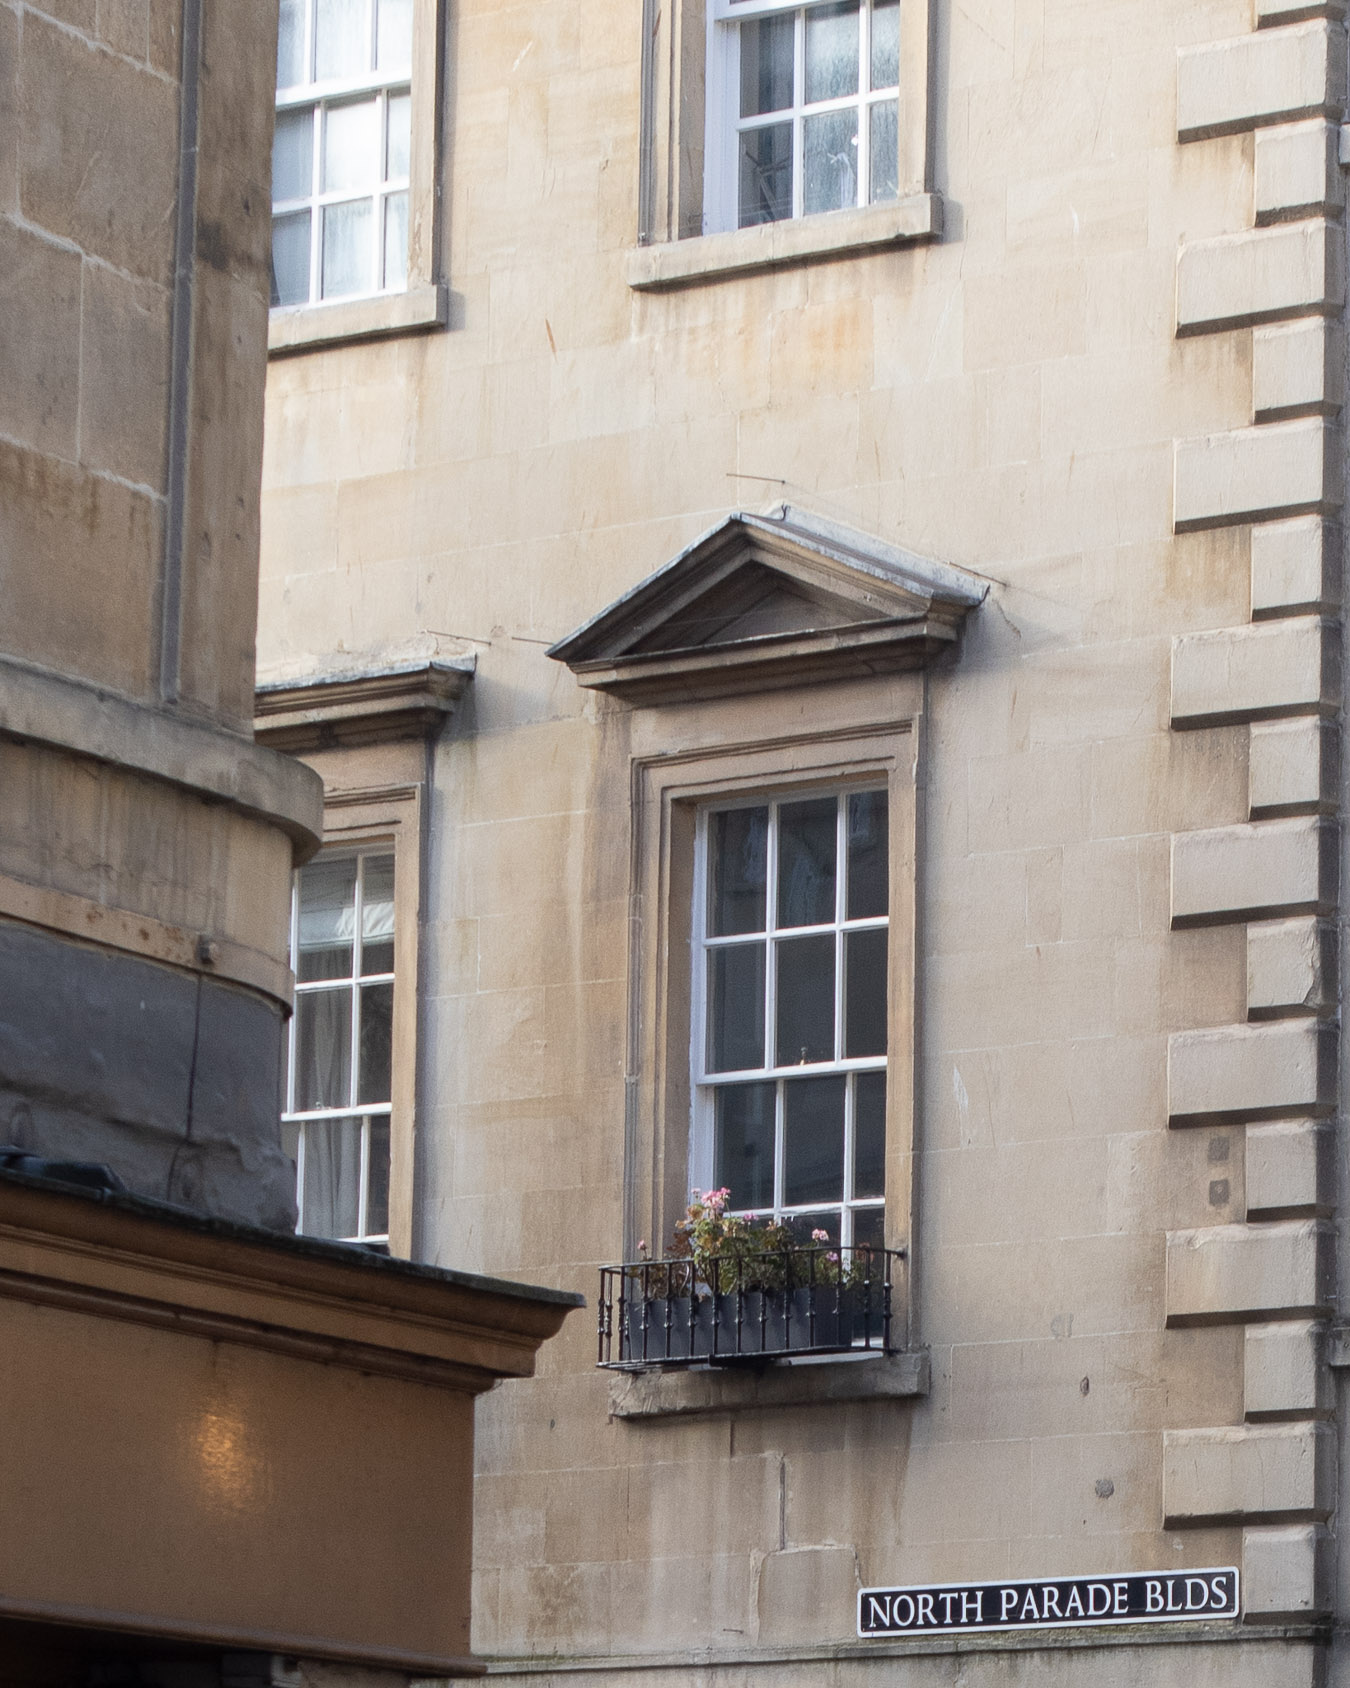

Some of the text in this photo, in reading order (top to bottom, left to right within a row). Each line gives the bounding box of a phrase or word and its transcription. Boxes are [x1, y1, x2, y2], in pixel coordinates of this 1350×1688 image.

[868, 1576, 1229, 1628] NORTH PARADE BLDS
